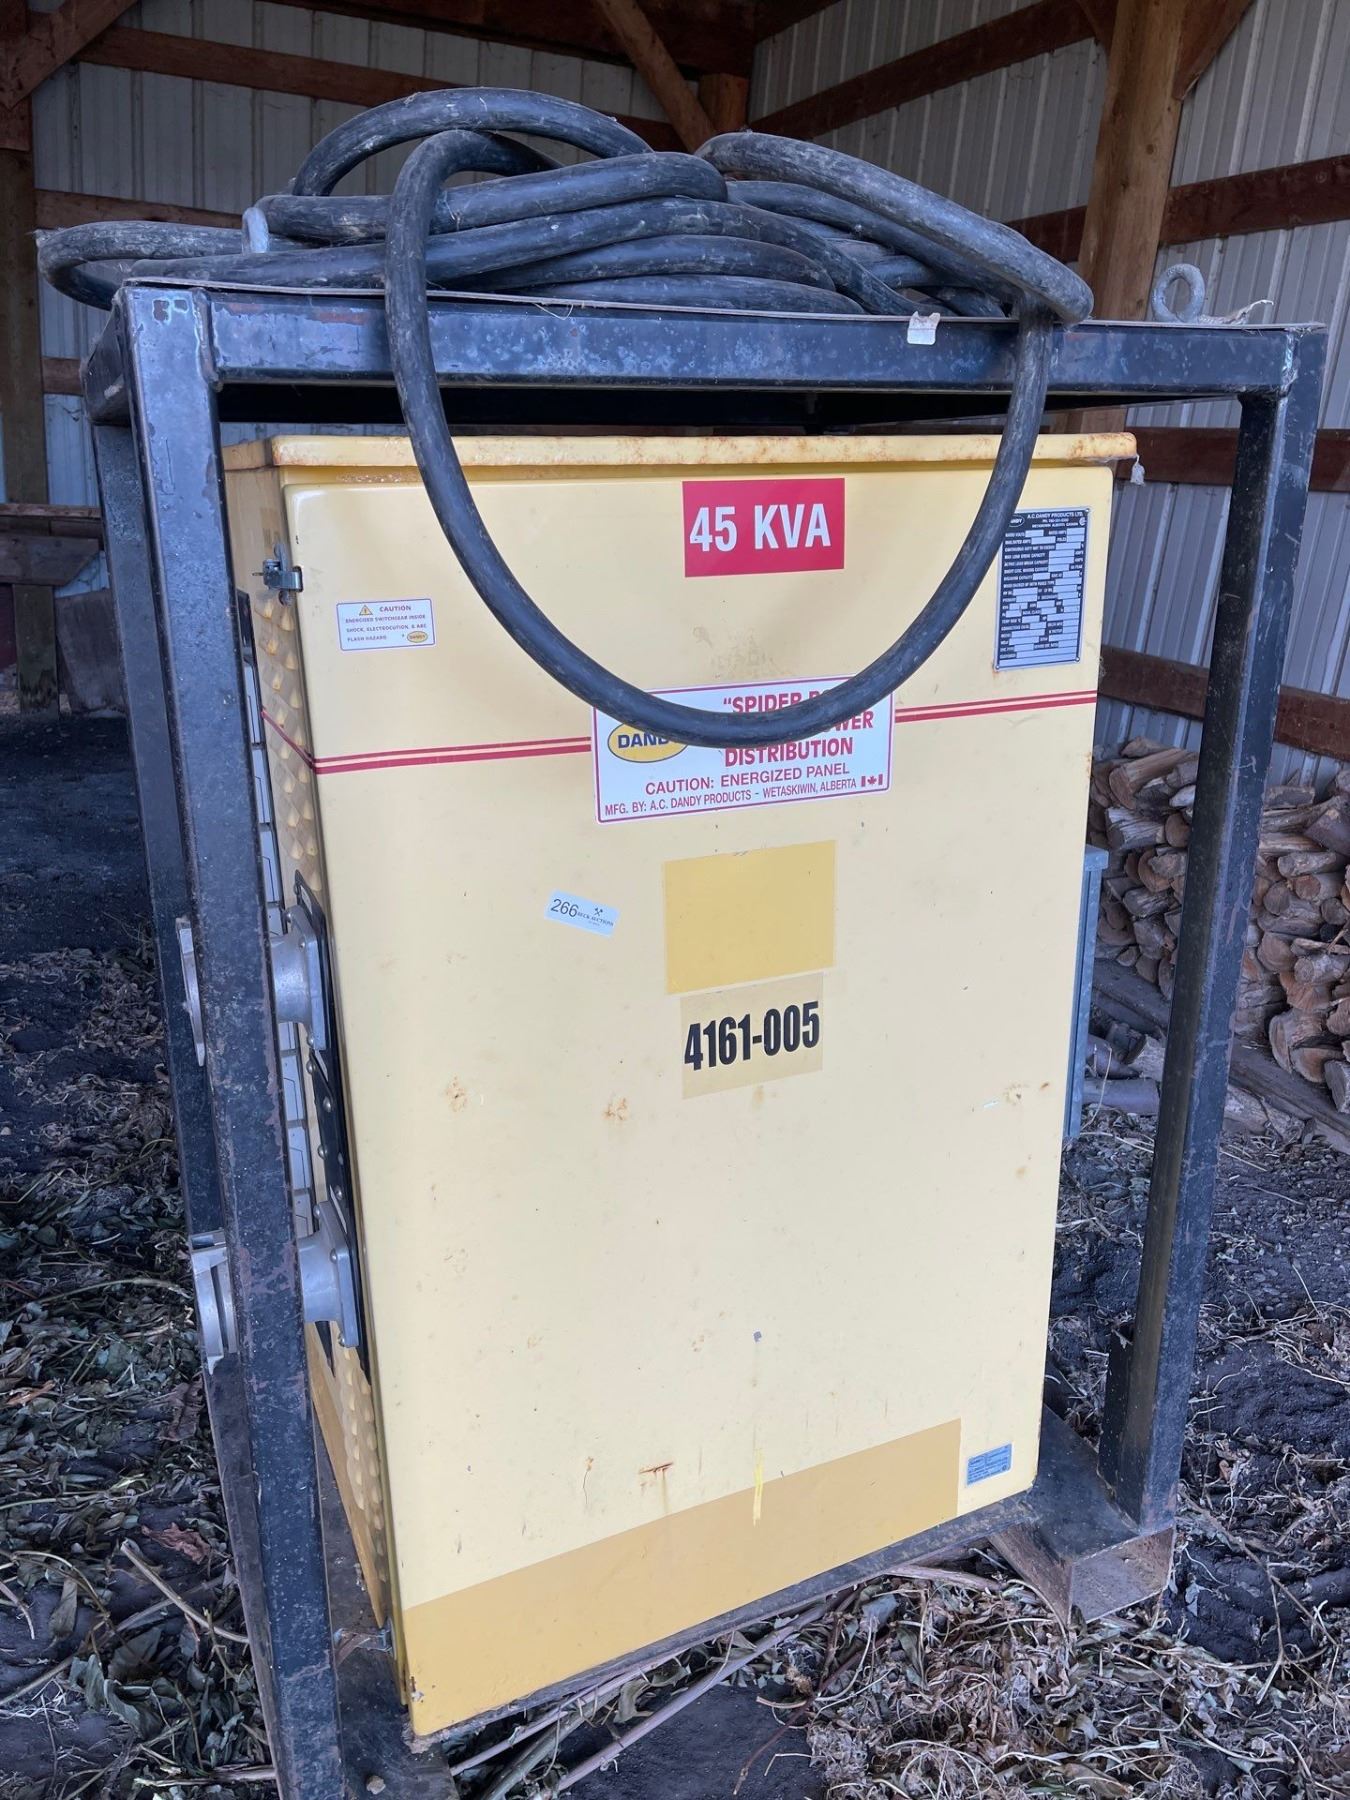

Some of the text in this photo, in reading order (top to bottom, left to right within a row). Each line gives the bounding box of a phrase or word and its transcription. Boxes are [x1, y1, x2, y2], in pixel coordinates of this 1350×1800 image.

[689, 503, 831, 552] 45 KVA
[725, 737, 853, 767] DISTRIBUTION
[605, 803, 629, 816] MFG.
[632, 801, 647, 813] BY:
[650, 798, 668, 811] A.C.
[671, 794, 701, 809] DANDY
[704, 789, 751, 805] PRODUCTS
[763, 782, 818, 799] WETASKIWIN,
[820, 778, 857, 792] ALBERTA
[645, 762, 850, 796] CAUTION: ENERGIZED PANEL
[550, 898, 579, 918] 266
[684, 1001, 820, 1071] 4161-005
